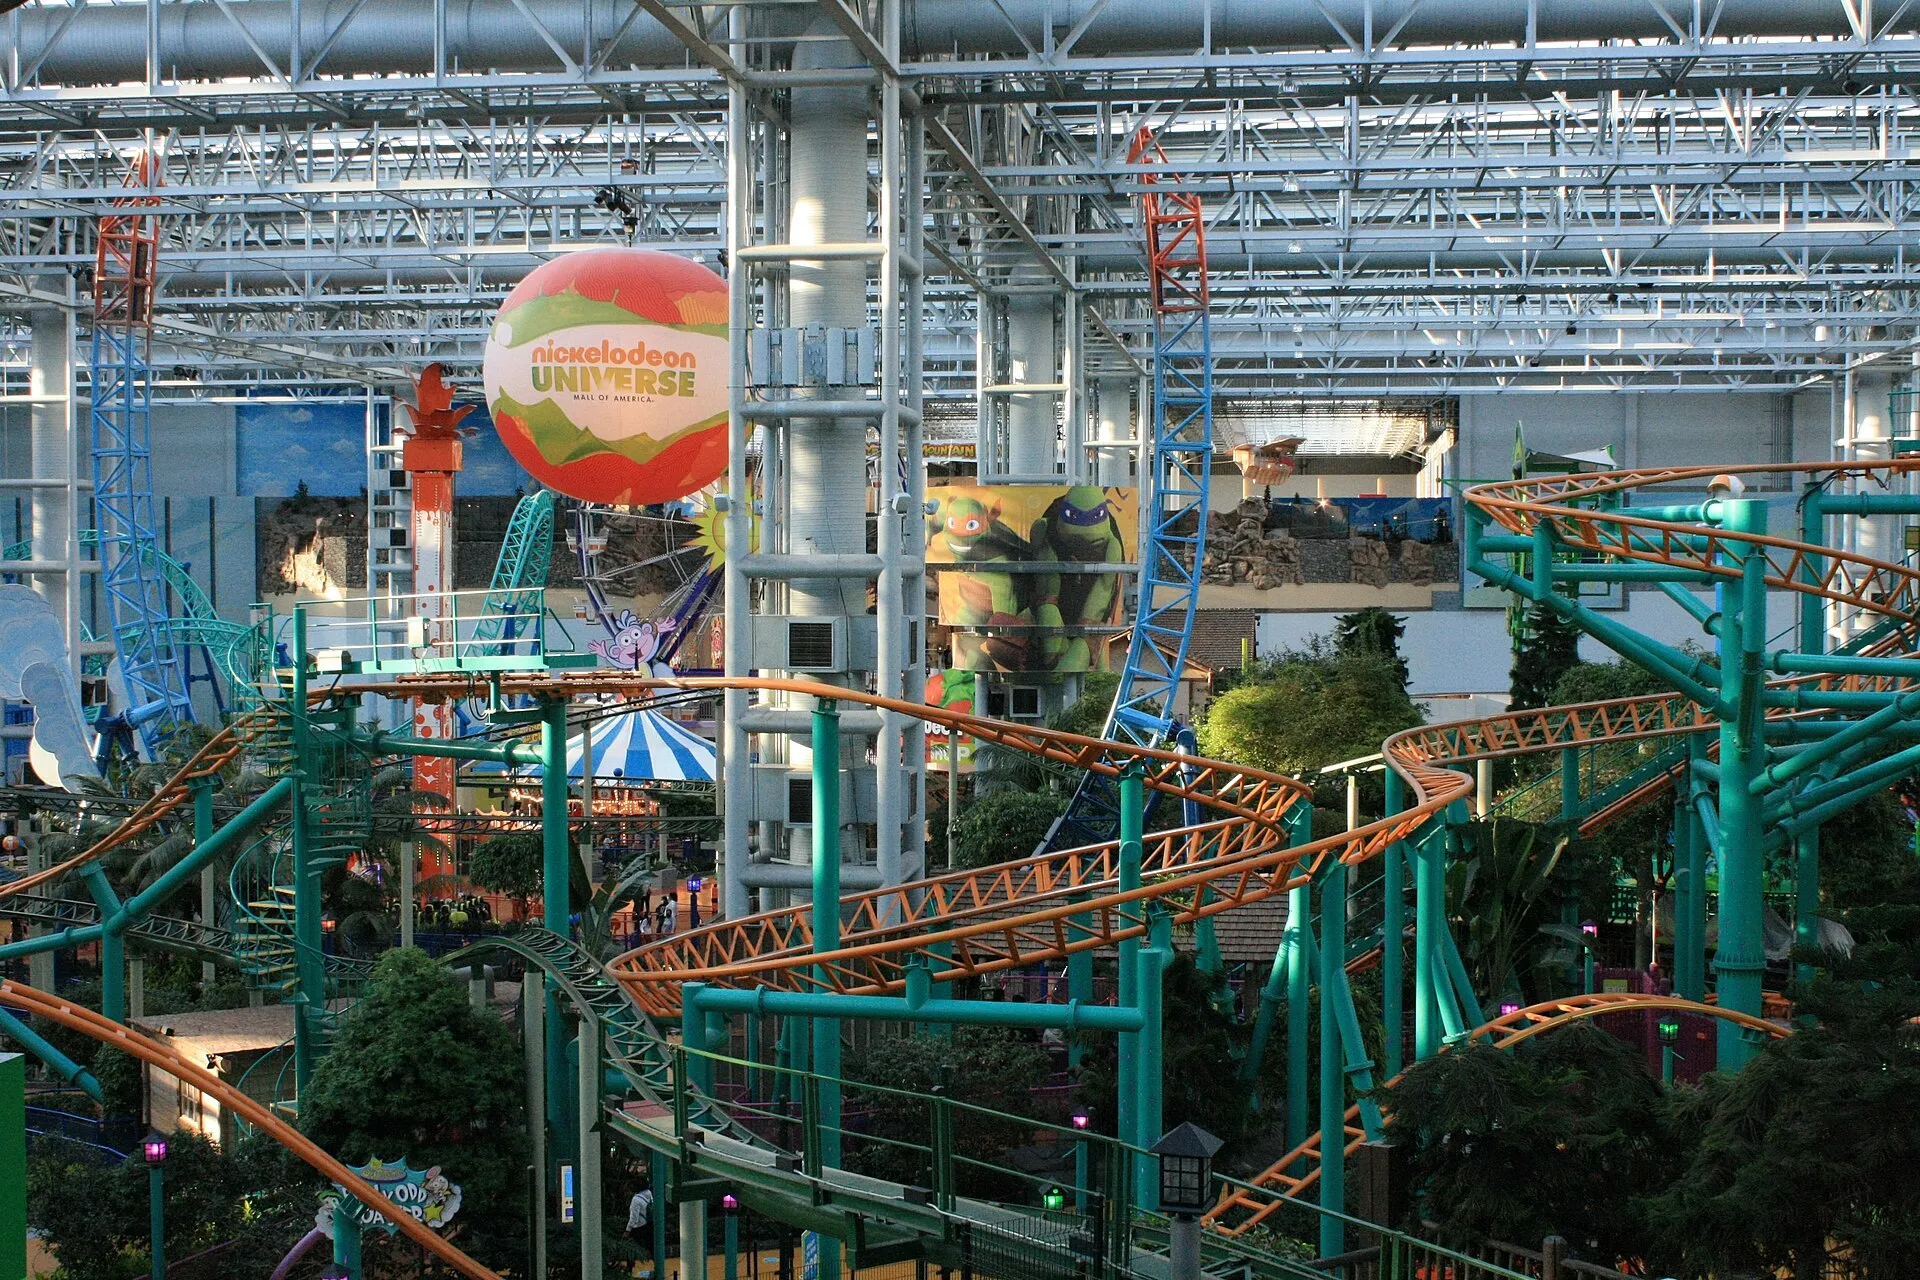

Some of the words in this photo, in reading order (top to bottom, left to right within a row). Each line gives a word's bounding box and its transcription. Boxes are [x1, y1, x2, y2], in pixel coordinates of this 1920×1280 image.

[531, 338, 697, 369] nickelodeon
[531, 366, 696, 397] UNIVERSE
[394, 1183, 427, 1202] ODD
